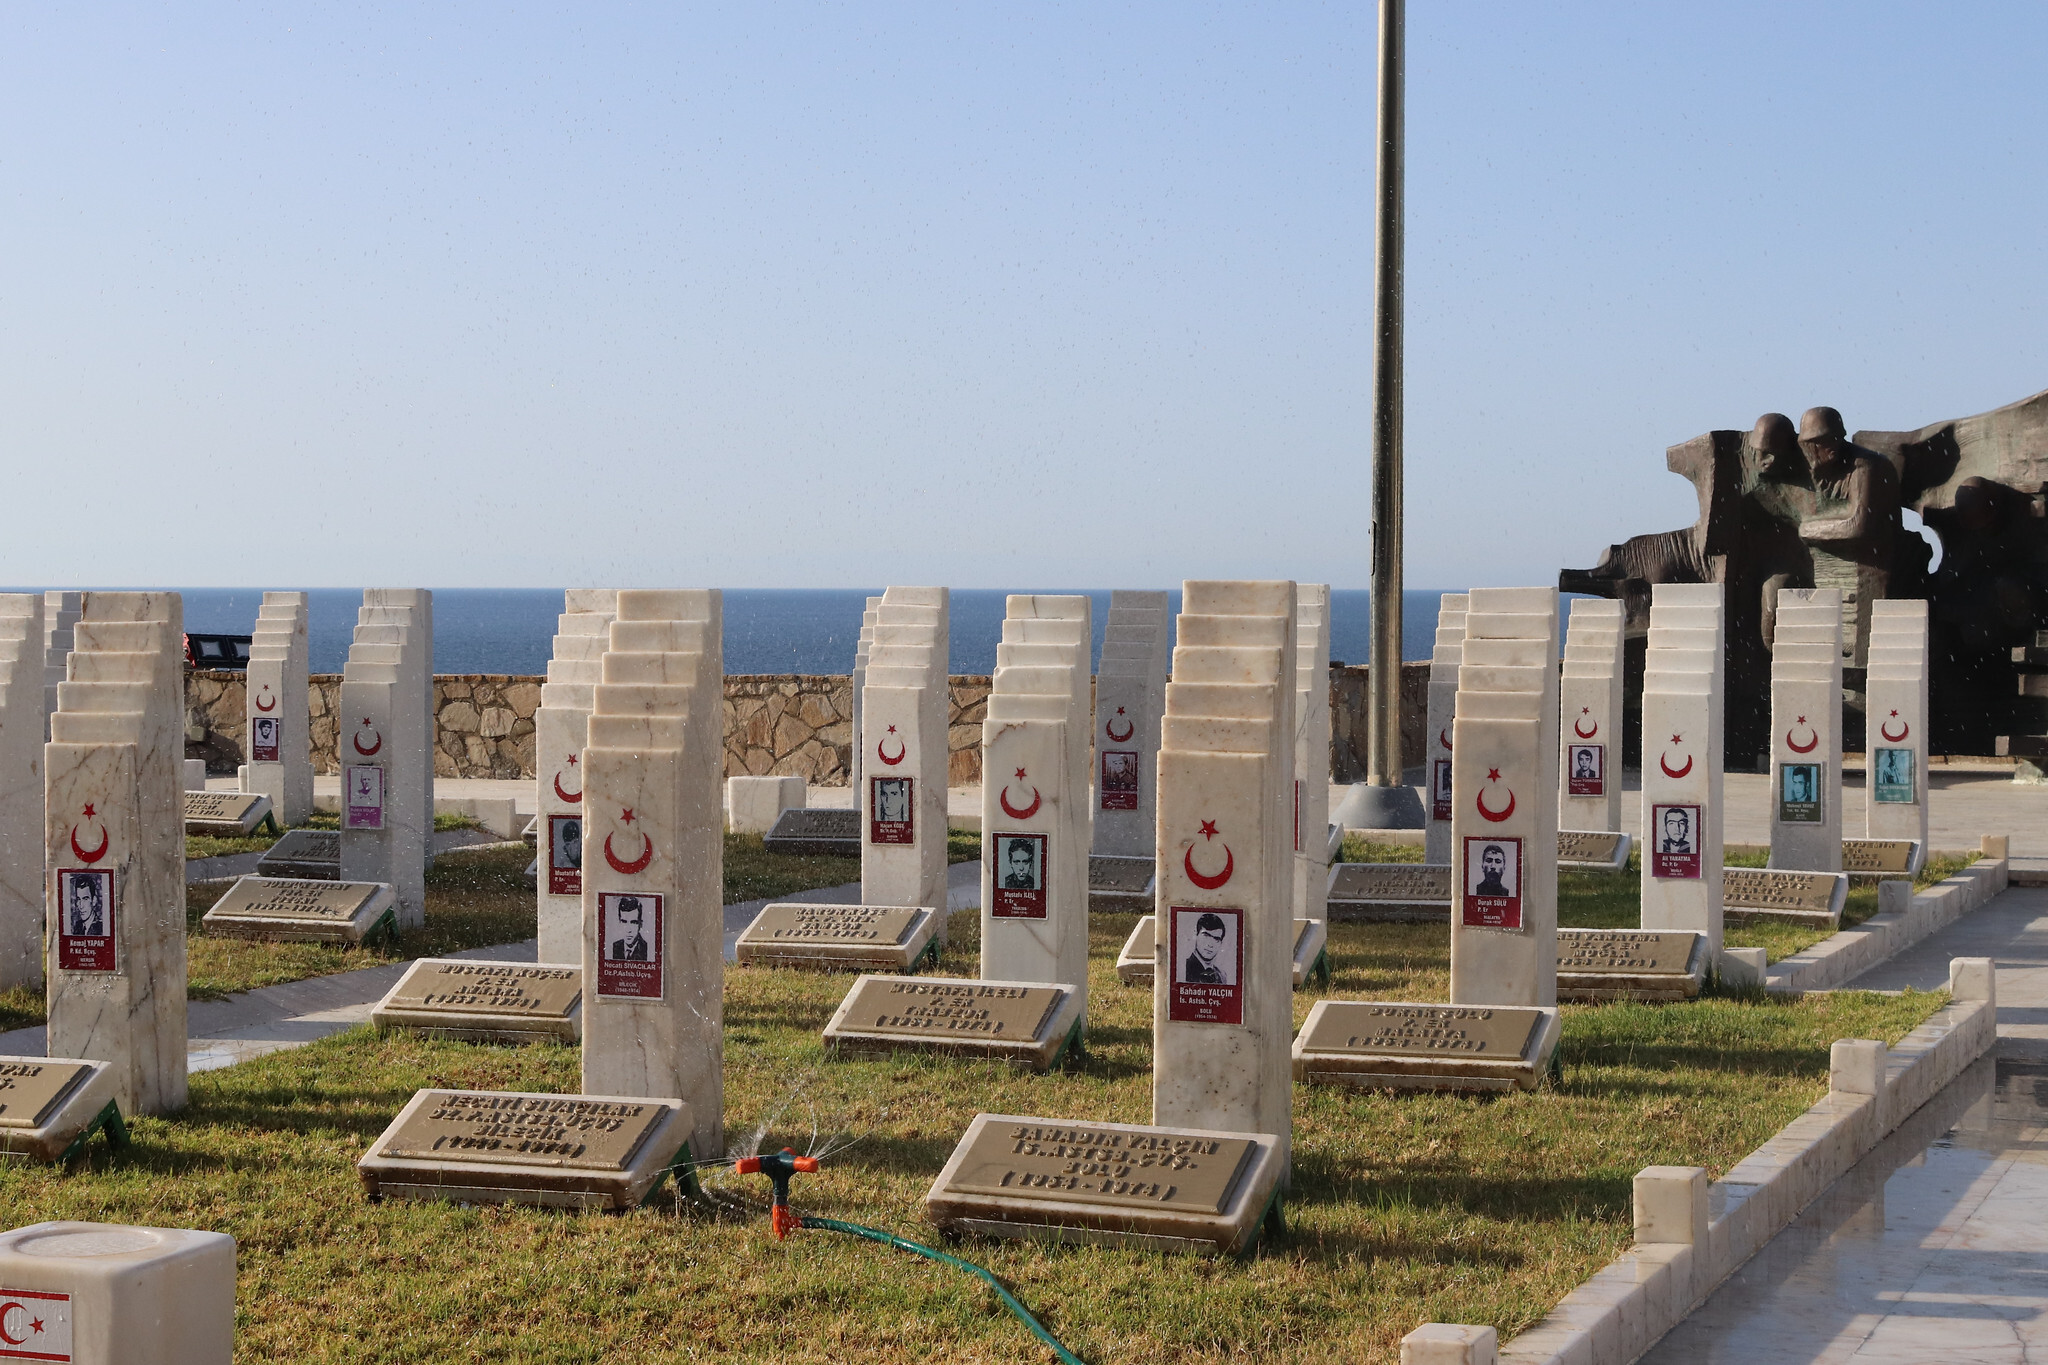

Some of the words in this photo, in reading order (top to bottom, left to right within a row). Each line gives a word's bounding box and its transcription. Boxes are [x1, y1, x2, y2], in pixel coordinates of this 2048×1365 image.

[70, 939, 86, 947] Kemal
[438, 965, 514, 977] MUSTAFA
[604, 961, 623, 969] Necati
[889, 983, 973, 997] MUSTAFA
[1179, 986, 1206, 996] Bahadır
[1208, 988, 1233, 999] YALÇIN
[1208, 998, 1222, 1007] Çvş.
[904, 1005, 990, 1020] TRABZON
[1369, 1008, 1437, 1018] DURAK
[1375, 1027, 1466, 1039] MALATYA
[439, 1095, 523, 1110] NECATİ
[472, 1123, 566, 1141] BİLECİK
[1009, 1126, 1121, 1148] BAHADIR
[1127, 1132, 1220, 1155] YALÇIN
[1062, 1161, 1132, 1178] BOLU
